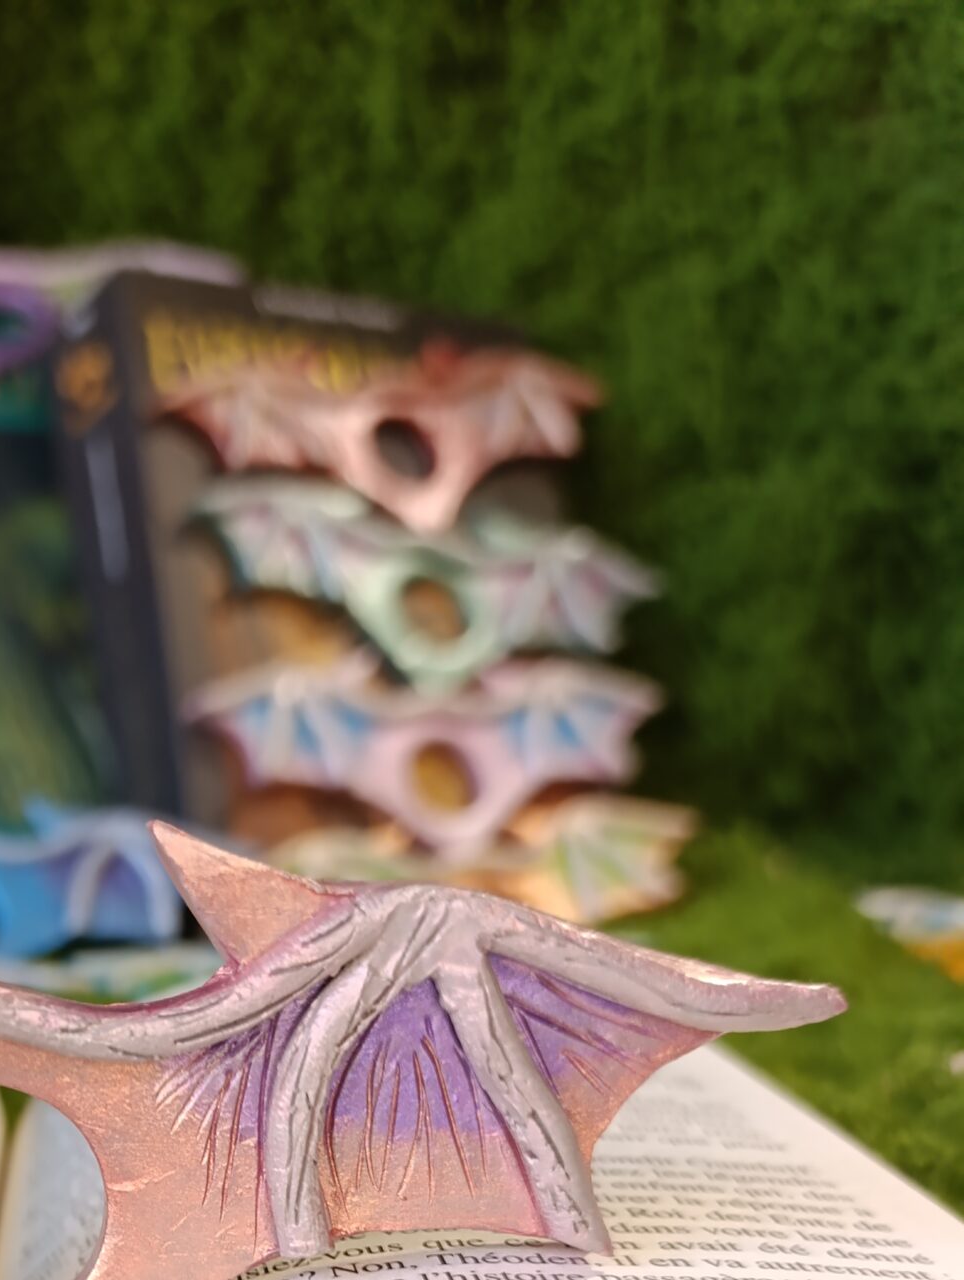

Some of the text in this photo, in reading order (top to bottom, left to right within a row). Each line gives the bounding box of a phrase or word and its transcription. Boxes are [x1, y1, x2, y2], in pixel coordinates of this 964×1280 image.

[705, 1209, 762, 1224] des
[852, 1220, 894, 1233] de
[609, 1221, 914, 1249] dans votre langue
[330, 1260, 418, 1278] Non,
[426, 1251, 603, 1267] Théoden,
[613, 1254, 640, 1267] il
[648, 1257, 694, 1268] en
[701, 1258, 748, 1270] va
[422, 1237, 485, 1251] que
[503, 1236, 544, 1248] ce
[657, 1239, 743, 1252] avait
[756, 1241, 811, 1257] été
[826, 1247, 935, 1266] donné
